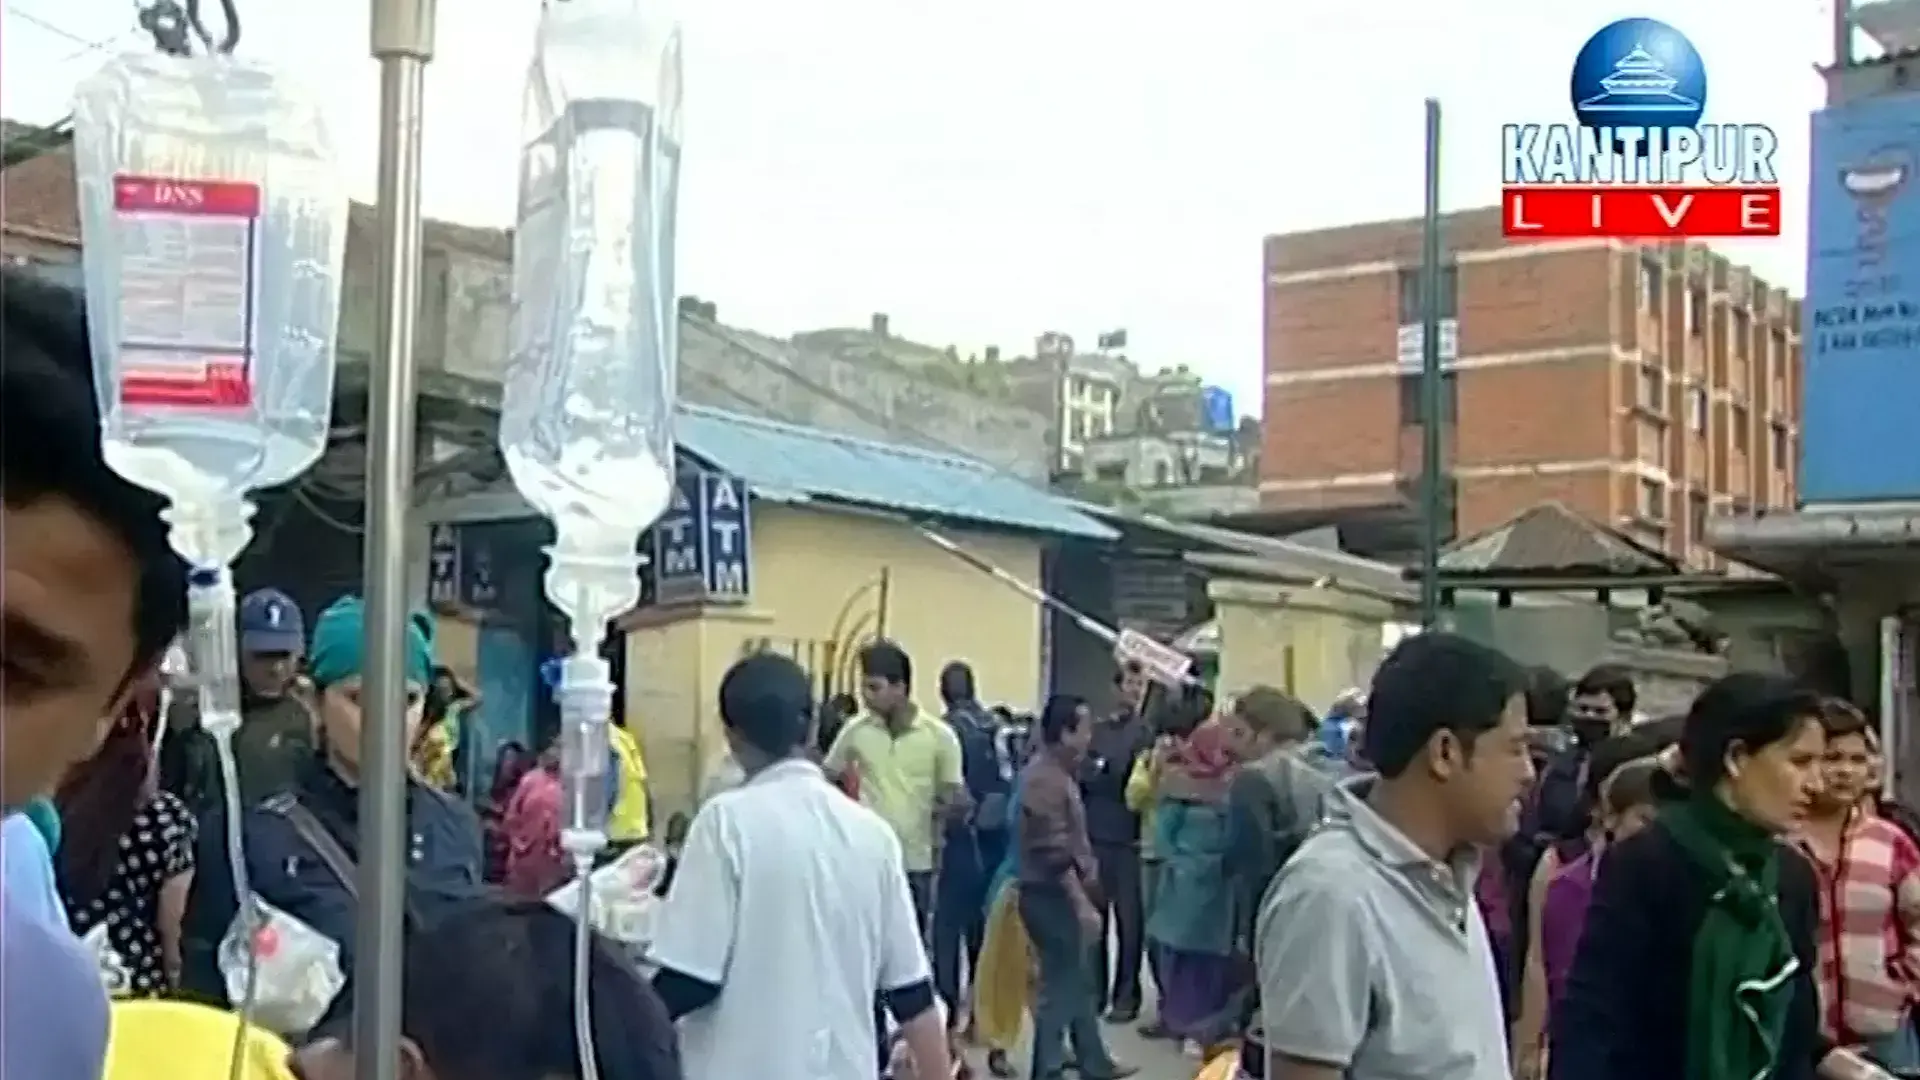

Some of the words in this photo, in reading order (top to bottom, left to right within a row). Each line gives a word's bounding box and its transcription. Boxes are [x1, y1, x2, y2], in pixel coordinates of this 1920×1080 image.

[432, 525, 453, 602] ATM
[660, 484, 696, 573] ATM
[712, 479, 743, 594] ATM
